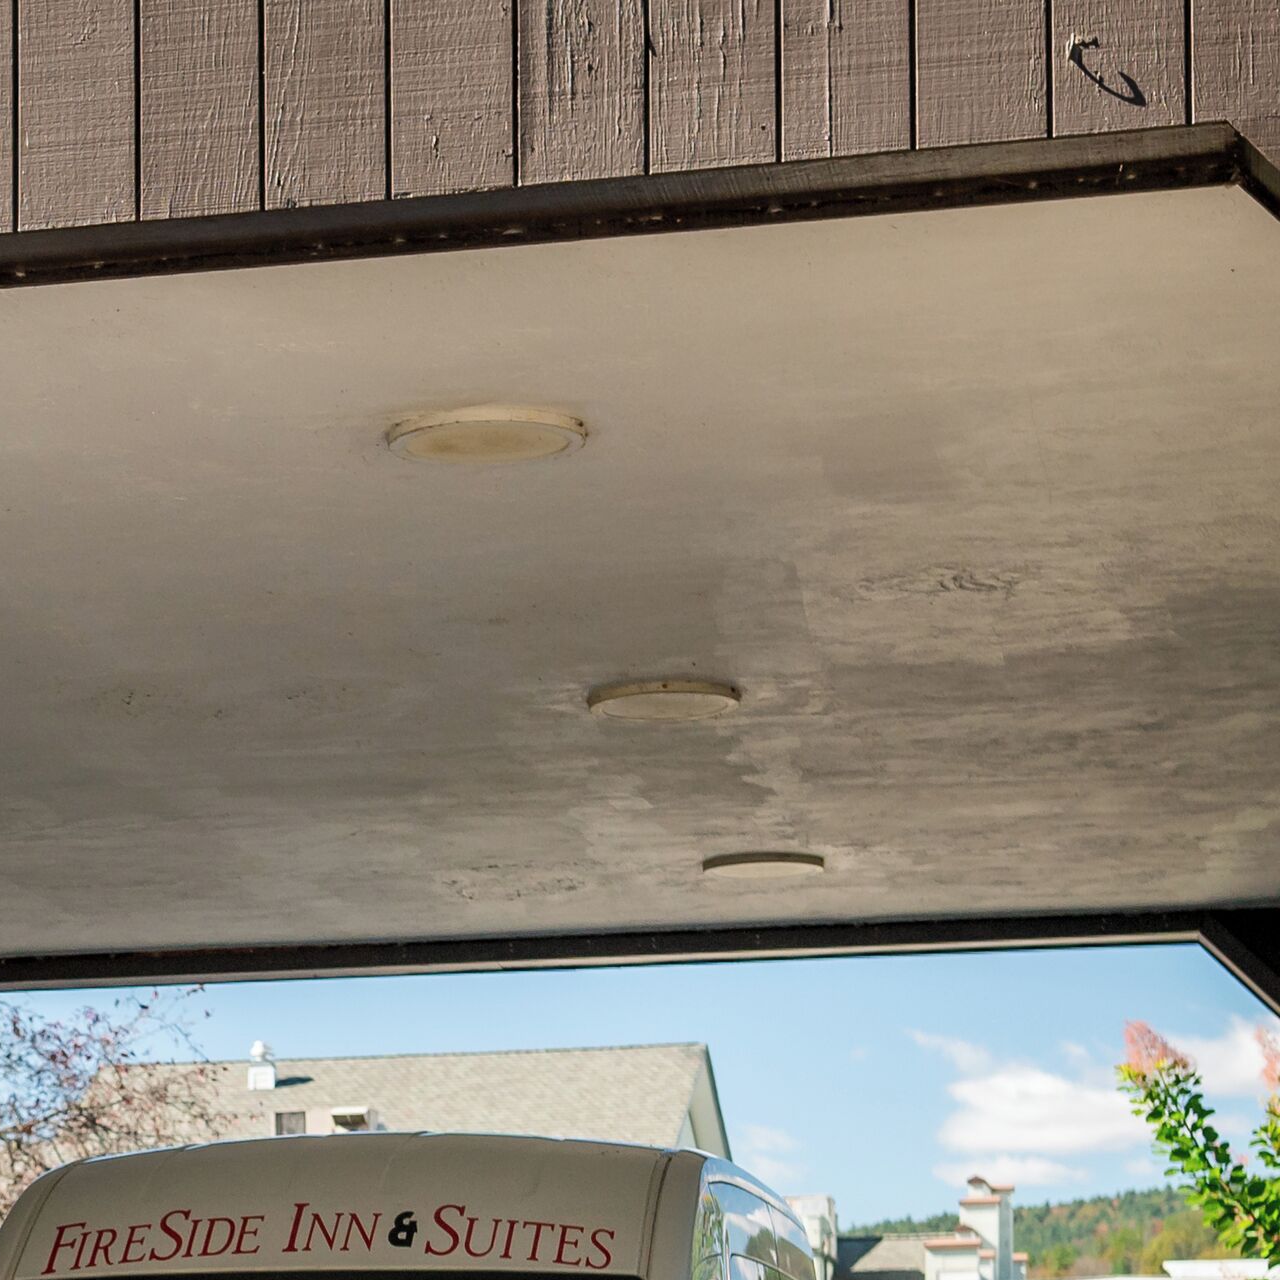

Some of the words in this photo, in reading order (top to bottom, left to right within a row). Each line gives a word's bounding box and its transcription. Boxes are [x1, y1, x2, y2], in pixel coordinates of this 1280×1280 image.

[282, 1202, 383, 1252] INN
[388, 1211, 418, 1248] &
[424, 1204, 615, 1270] SUITES
